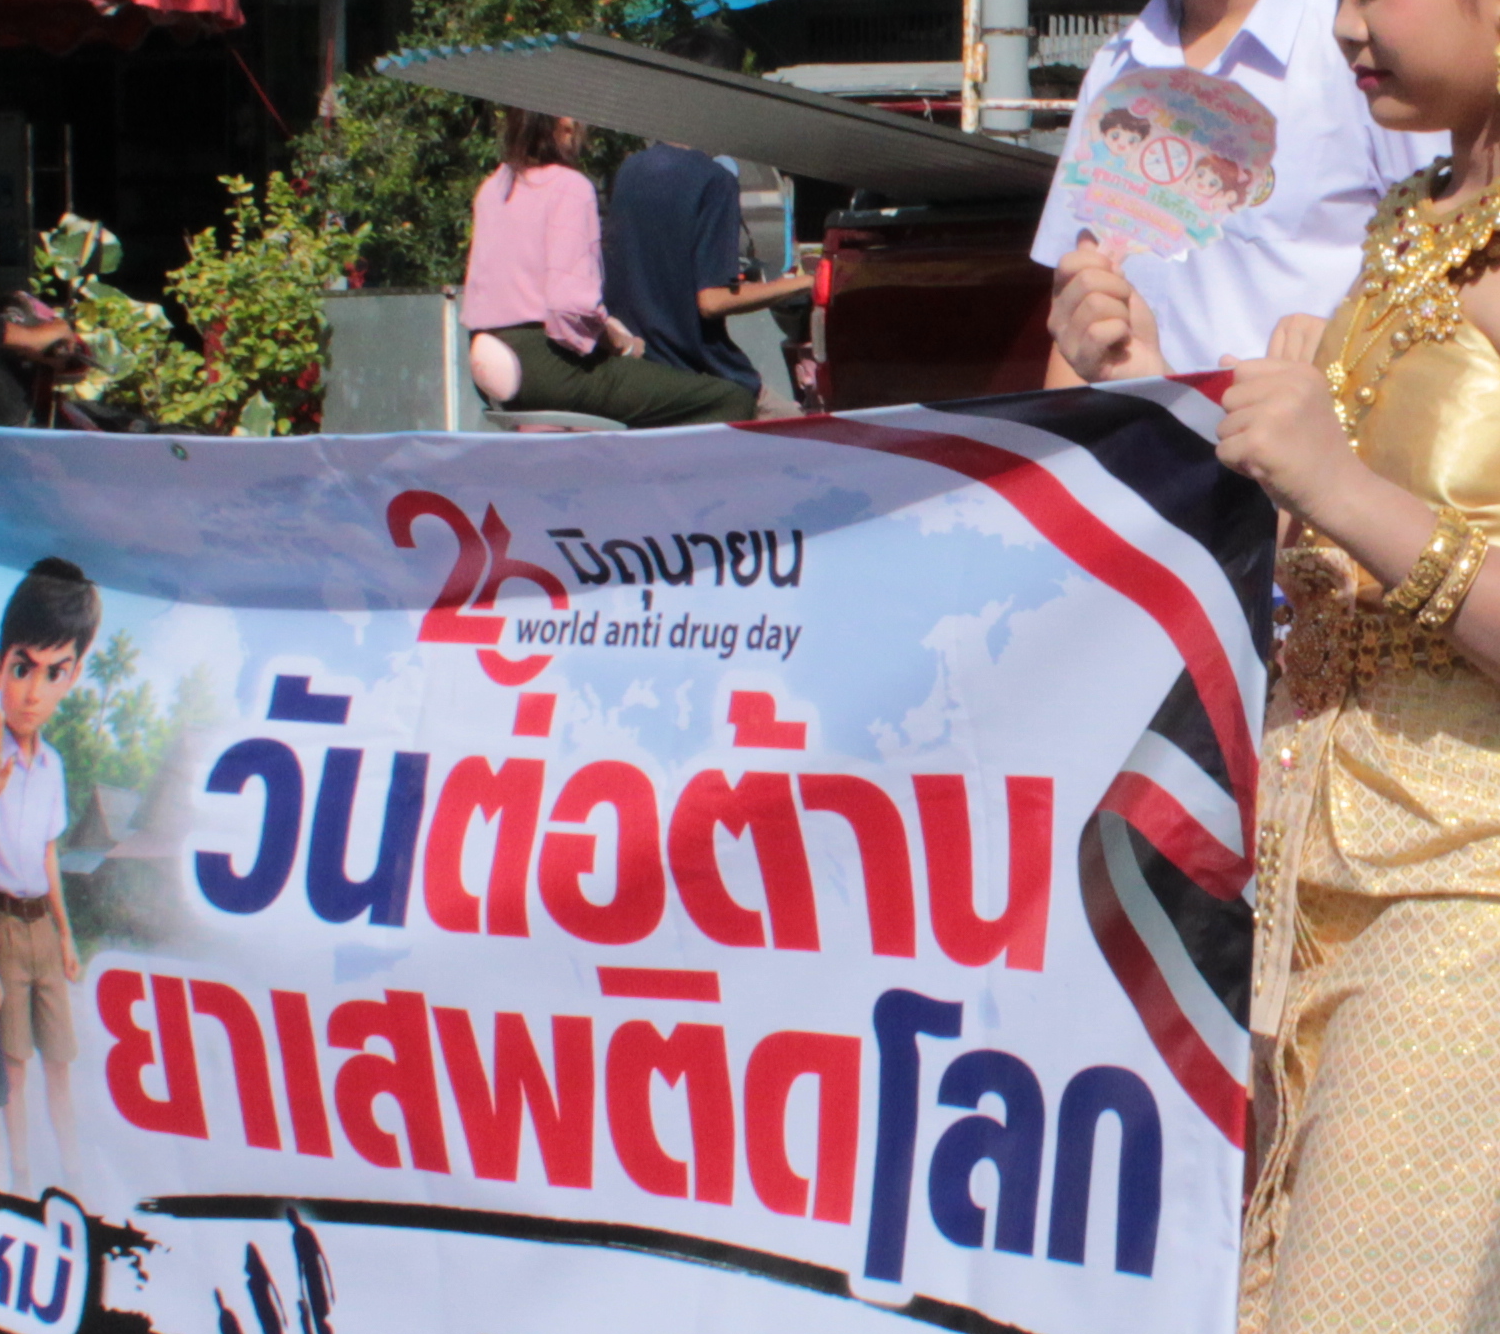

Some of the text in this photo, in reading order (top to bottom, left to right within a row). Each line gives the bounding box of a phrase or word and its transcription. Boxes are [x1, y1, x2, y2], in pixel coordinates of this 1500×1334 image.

[386, 489, 803, 686] 26 มิถุนายน
[516, 610, 804, 662] world anti drug day
[193, 672, 1055, 973] วันต่อต้าน
[96, 966, 1165, 1283] ยาเสพติดโลก
